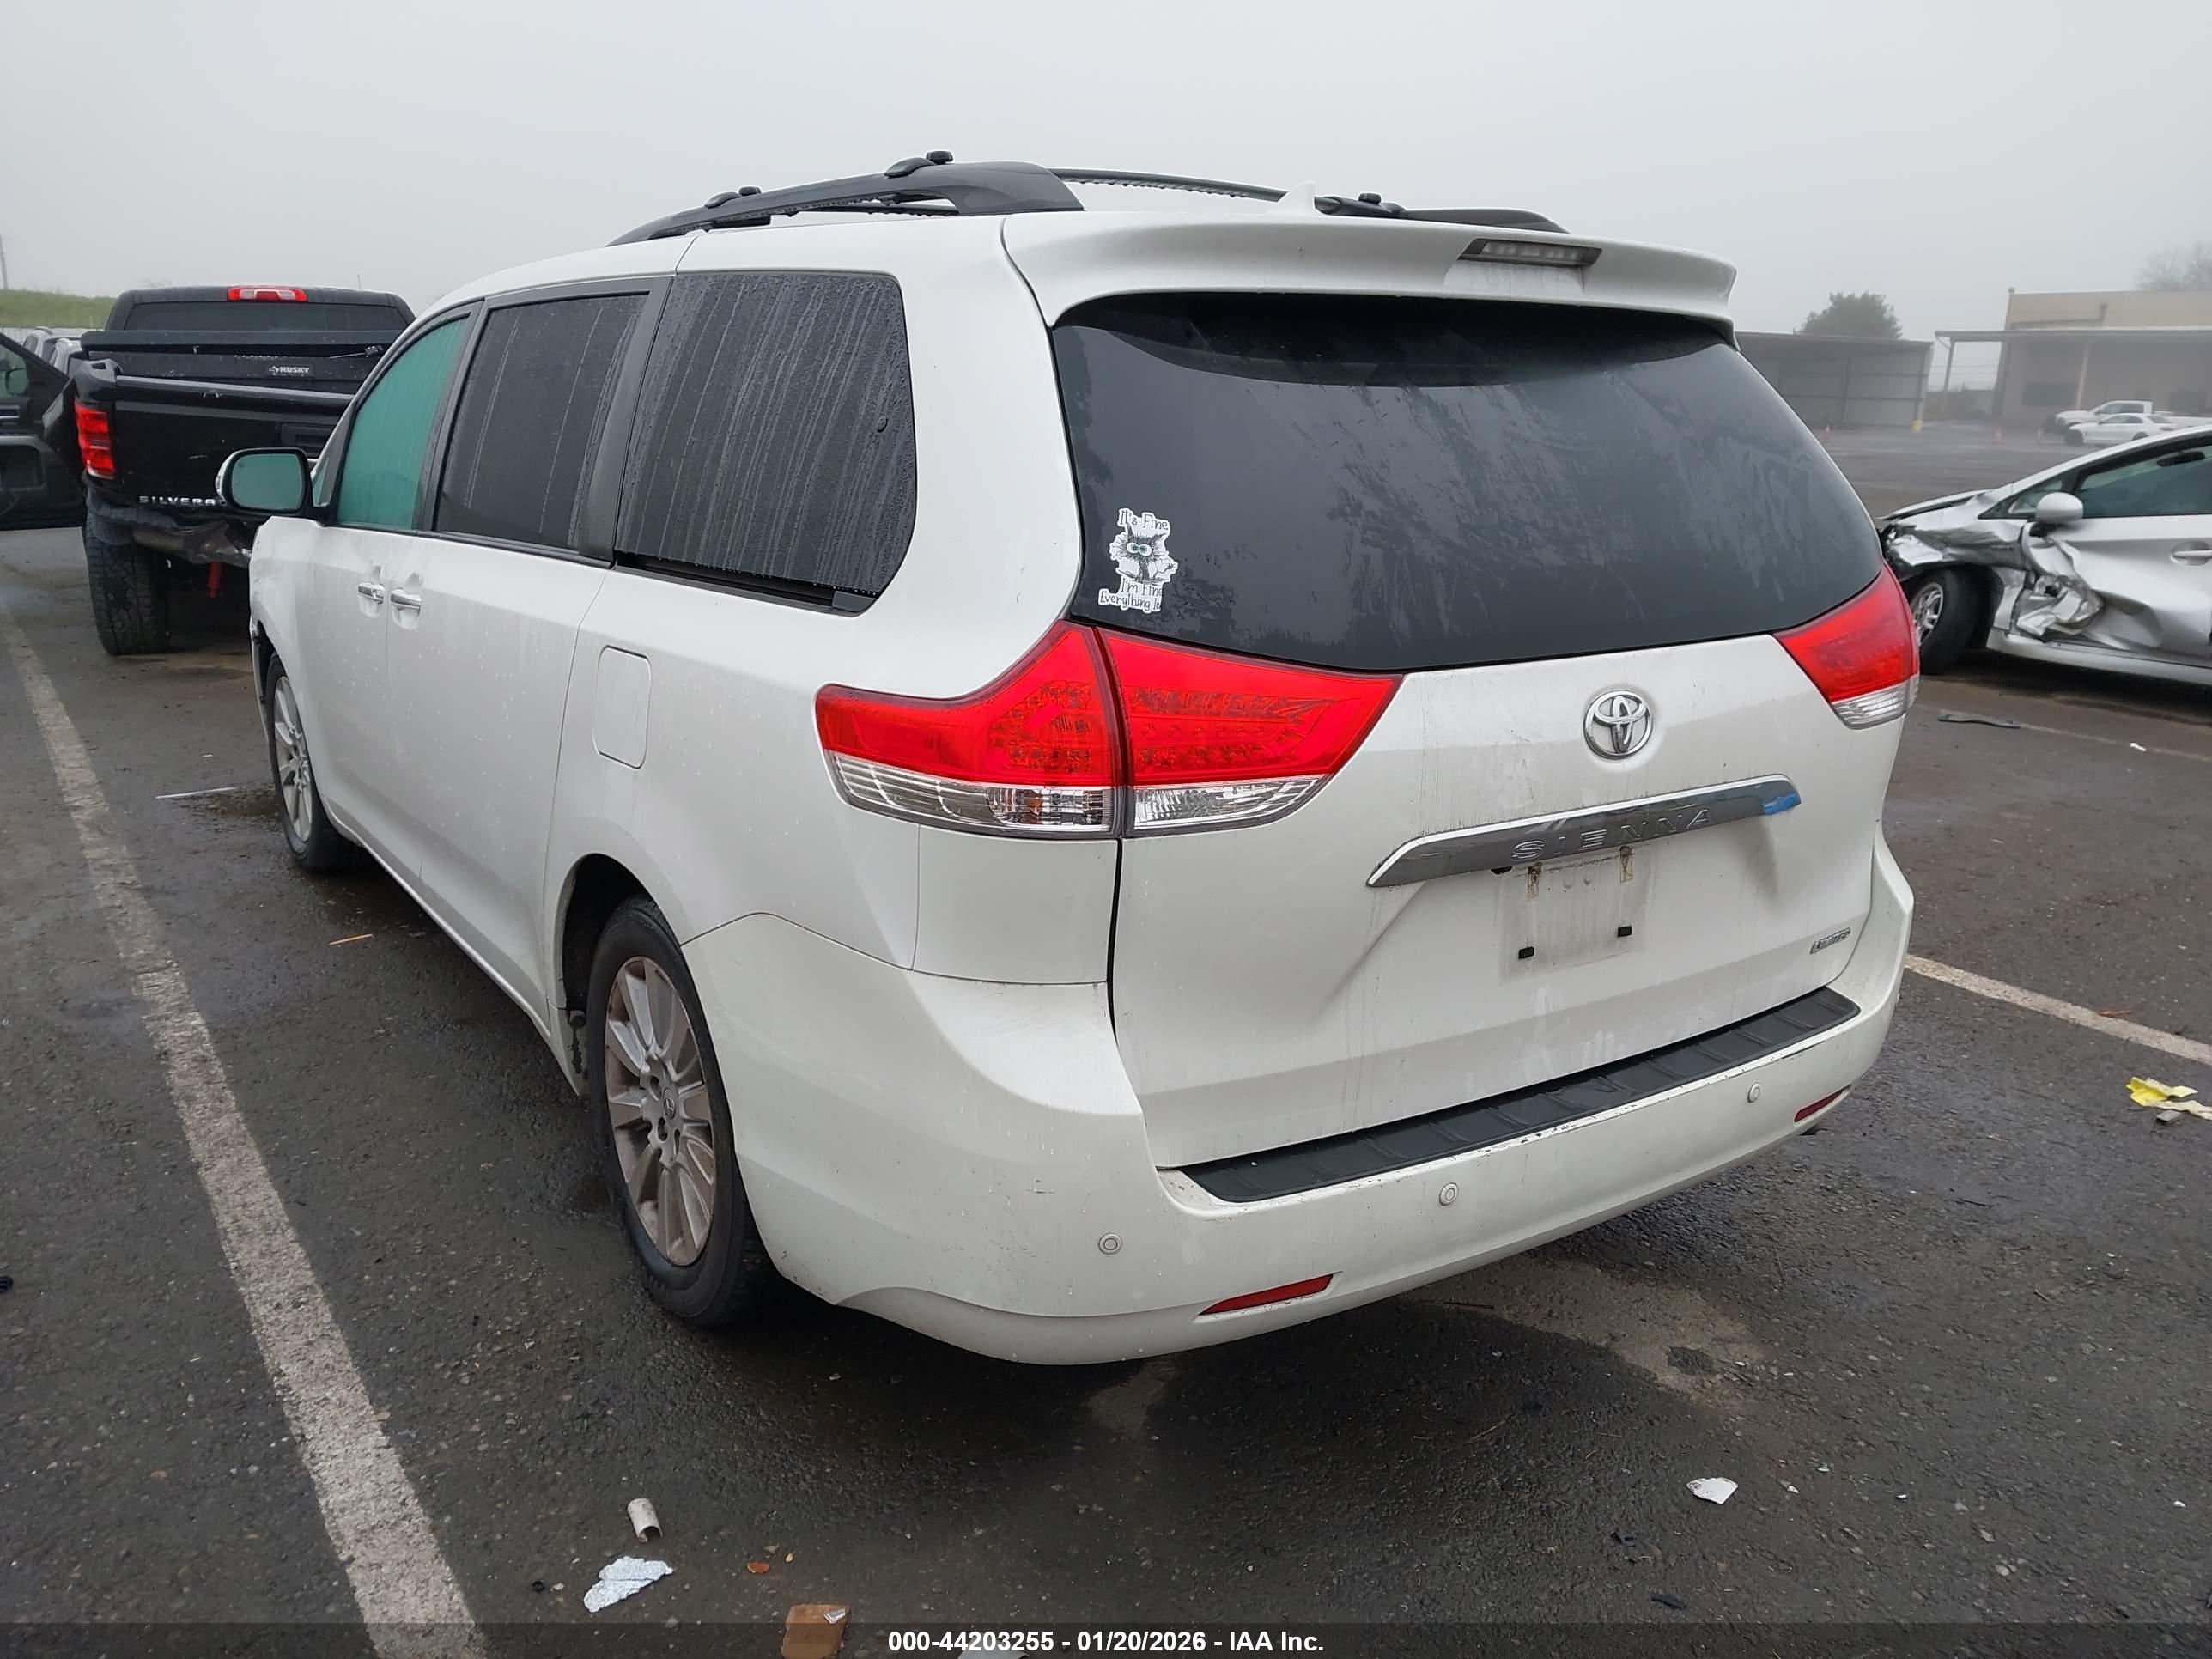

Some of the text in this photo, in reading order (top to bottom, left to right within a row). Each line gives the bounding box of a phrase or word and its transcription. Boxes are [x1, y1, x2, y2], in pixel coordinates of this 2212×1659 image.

[1143, 514, 1169, 530] Fine
[1121, 577, 1139, 594] I'm
[1511, 809, 1712, 860] SIENNA
